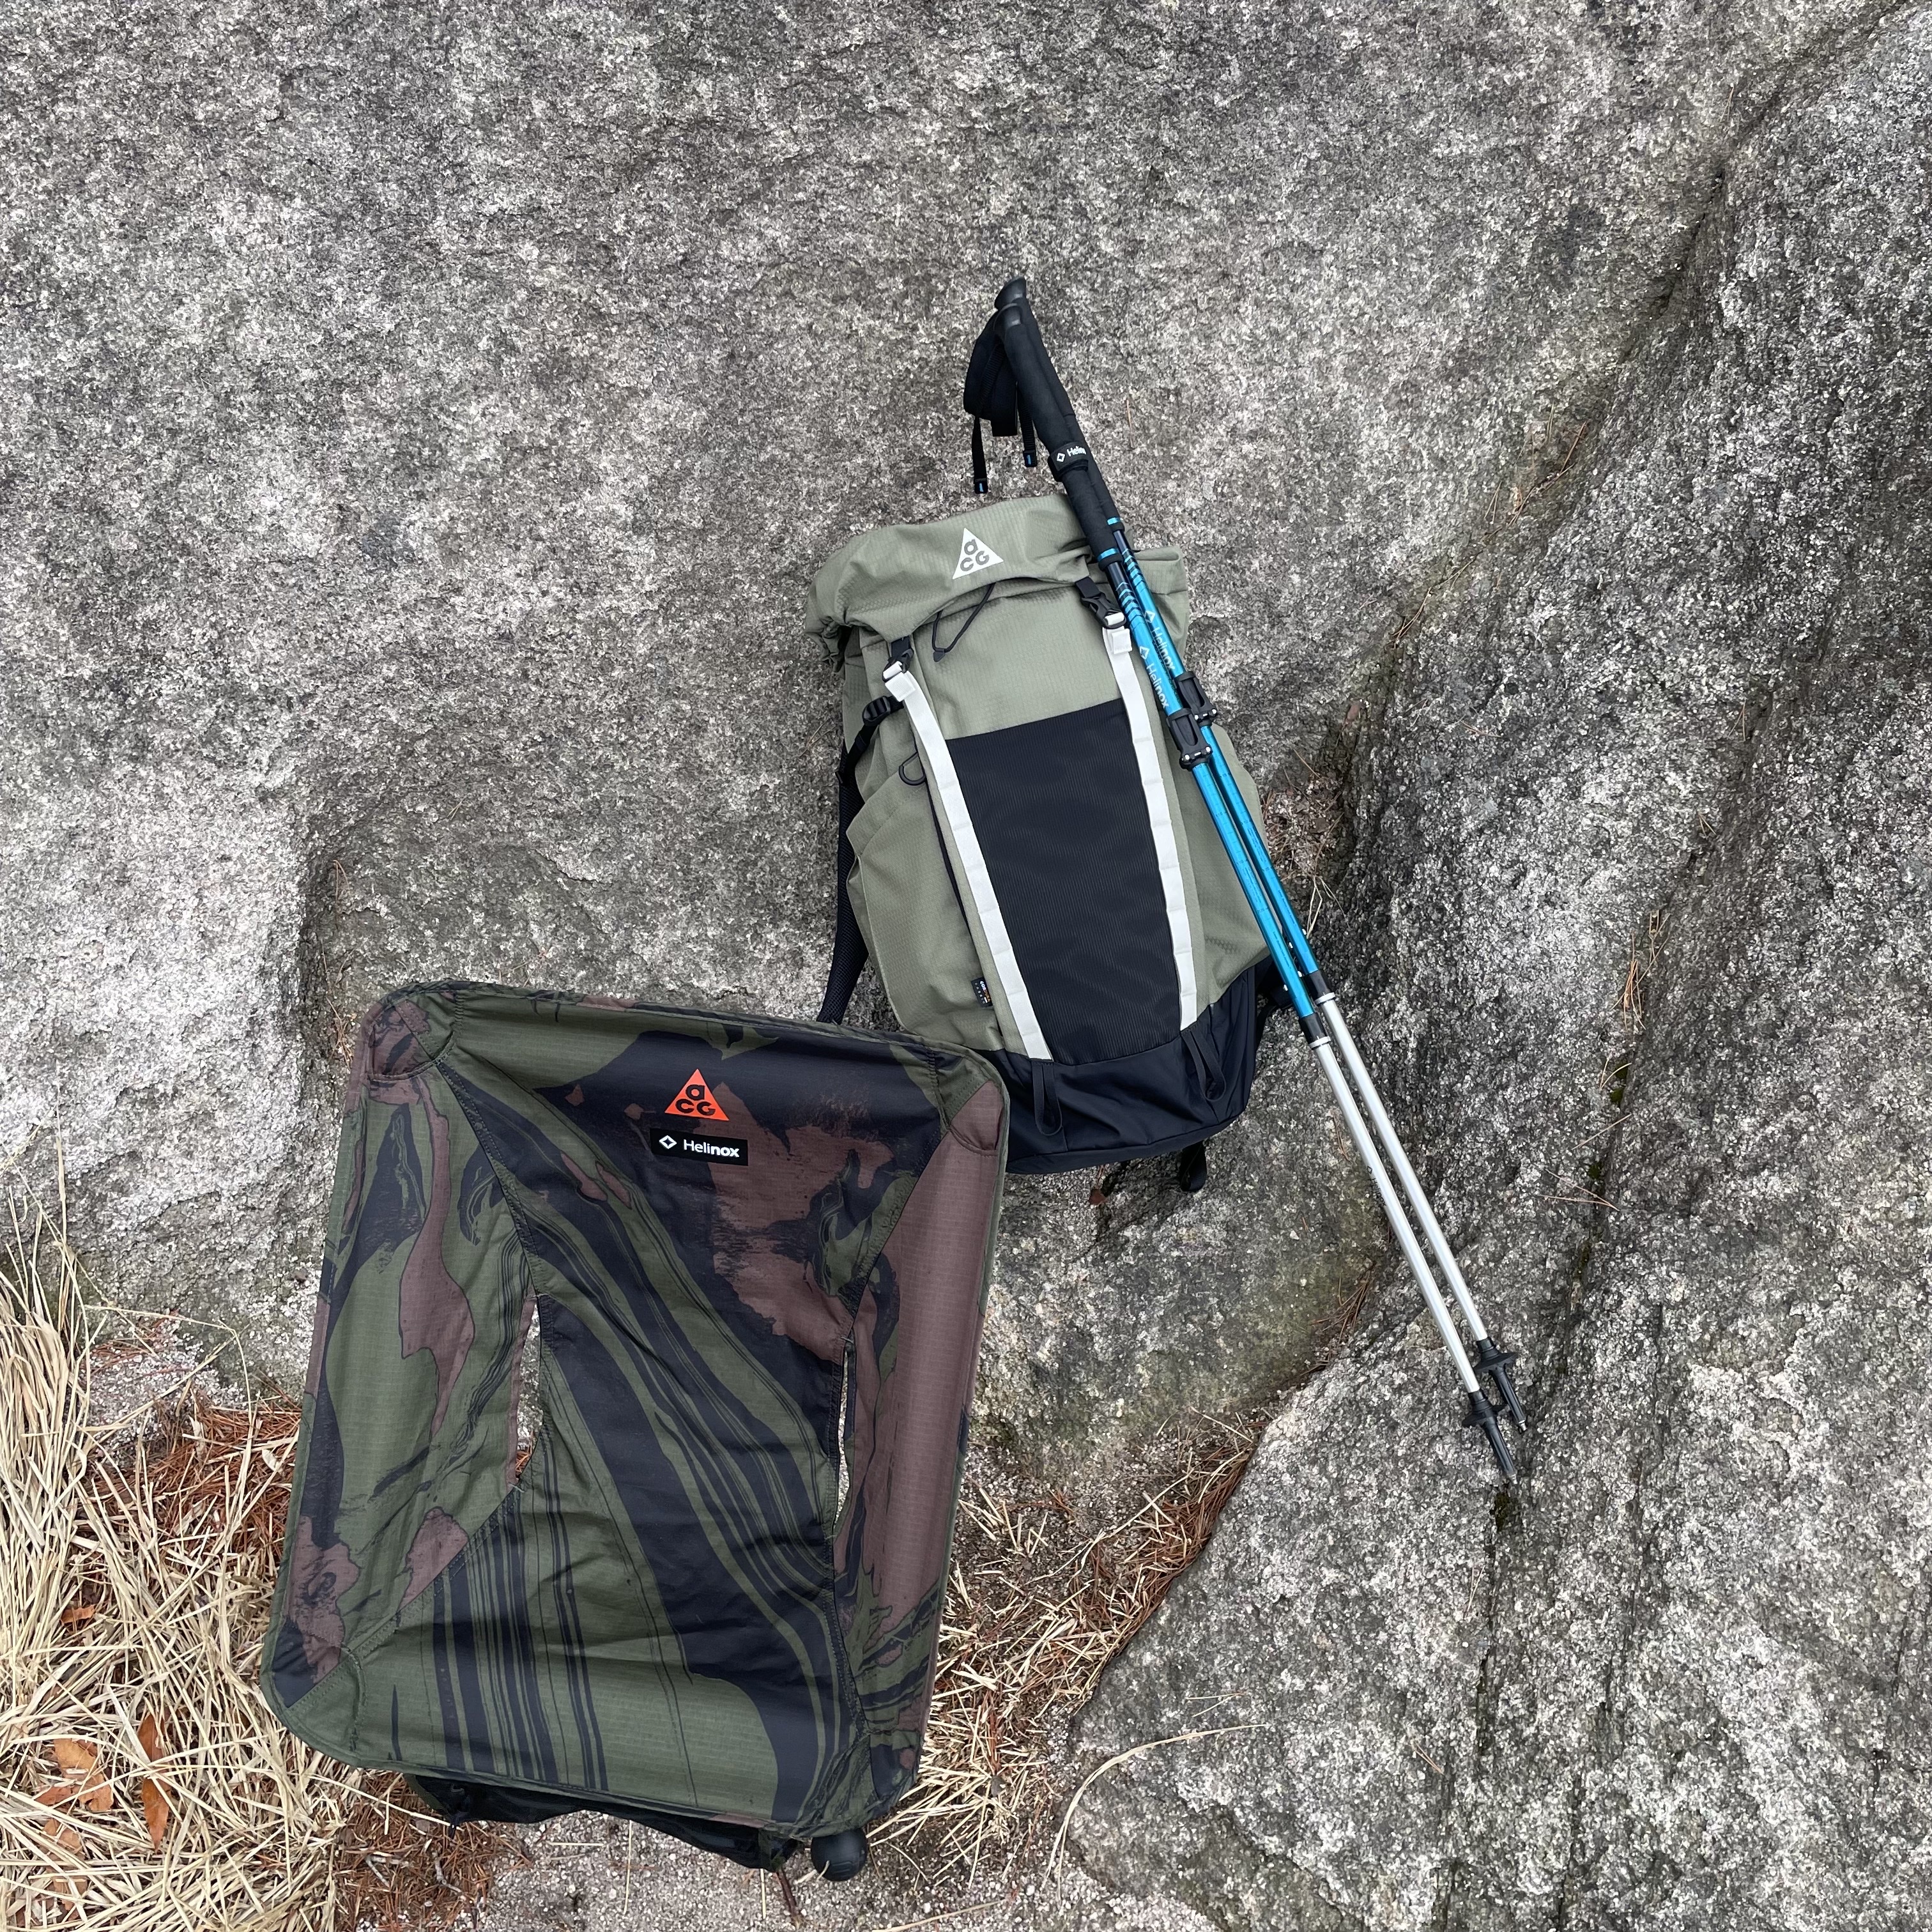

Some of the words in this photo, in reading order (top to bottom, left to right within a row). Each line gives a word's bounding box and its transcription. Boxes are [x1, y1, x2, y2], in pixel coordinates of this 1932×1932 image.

[1151, 626, 1176, 670] Helinox
[1146, 663, 1169, 709] Helinox
[683, 1139, 740, 1158] Helinox
